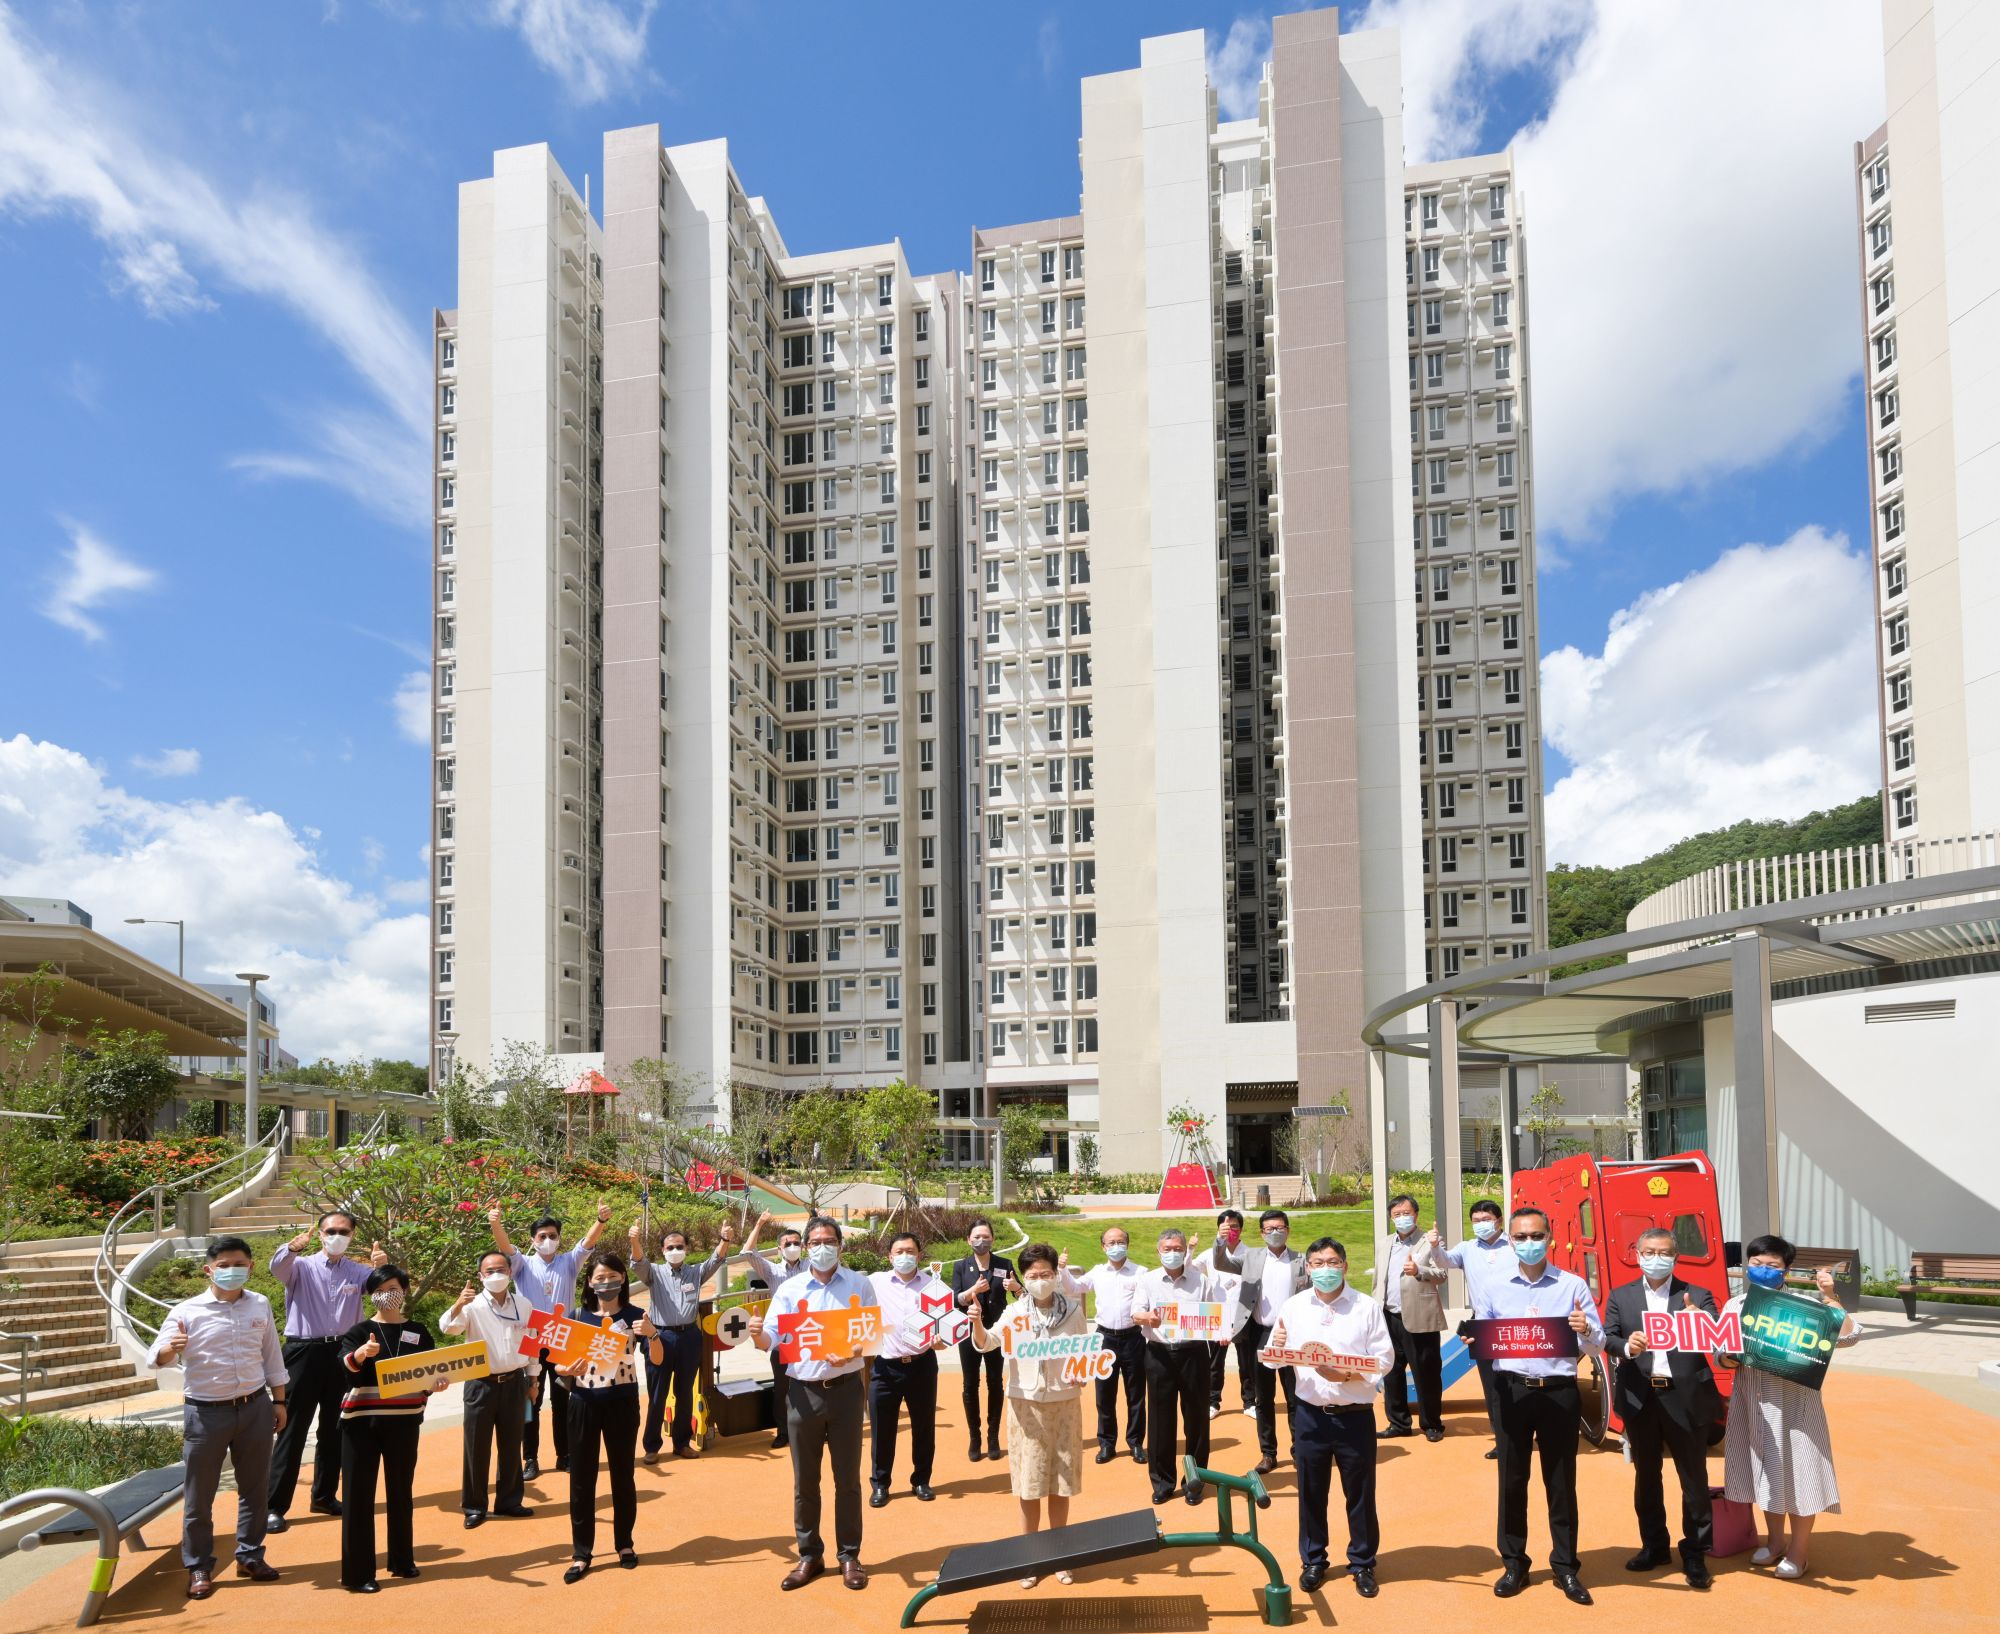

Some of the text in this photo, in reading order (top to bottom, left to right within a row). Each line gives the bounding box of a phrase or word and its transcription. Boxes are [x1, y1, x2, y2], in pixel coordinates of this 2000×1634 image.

[794, 1311, 877, 1348] 合成
[1180, 1315, 1221, 1331] MODULES
[1496, 1324, 1546, 1341] 百勝角
[1643, 1312, 1743, 1352] BIM
[1754, 1314, 1819, 1350] RFID
[538, 1319, 621, 1364] 組裝
[1016, 1335, 1101, 1359] CONCRETE
[1491, 1341, 1554, 1351] Pak Shing Kok
[1064, 1351, 1113, 1379] MiC
